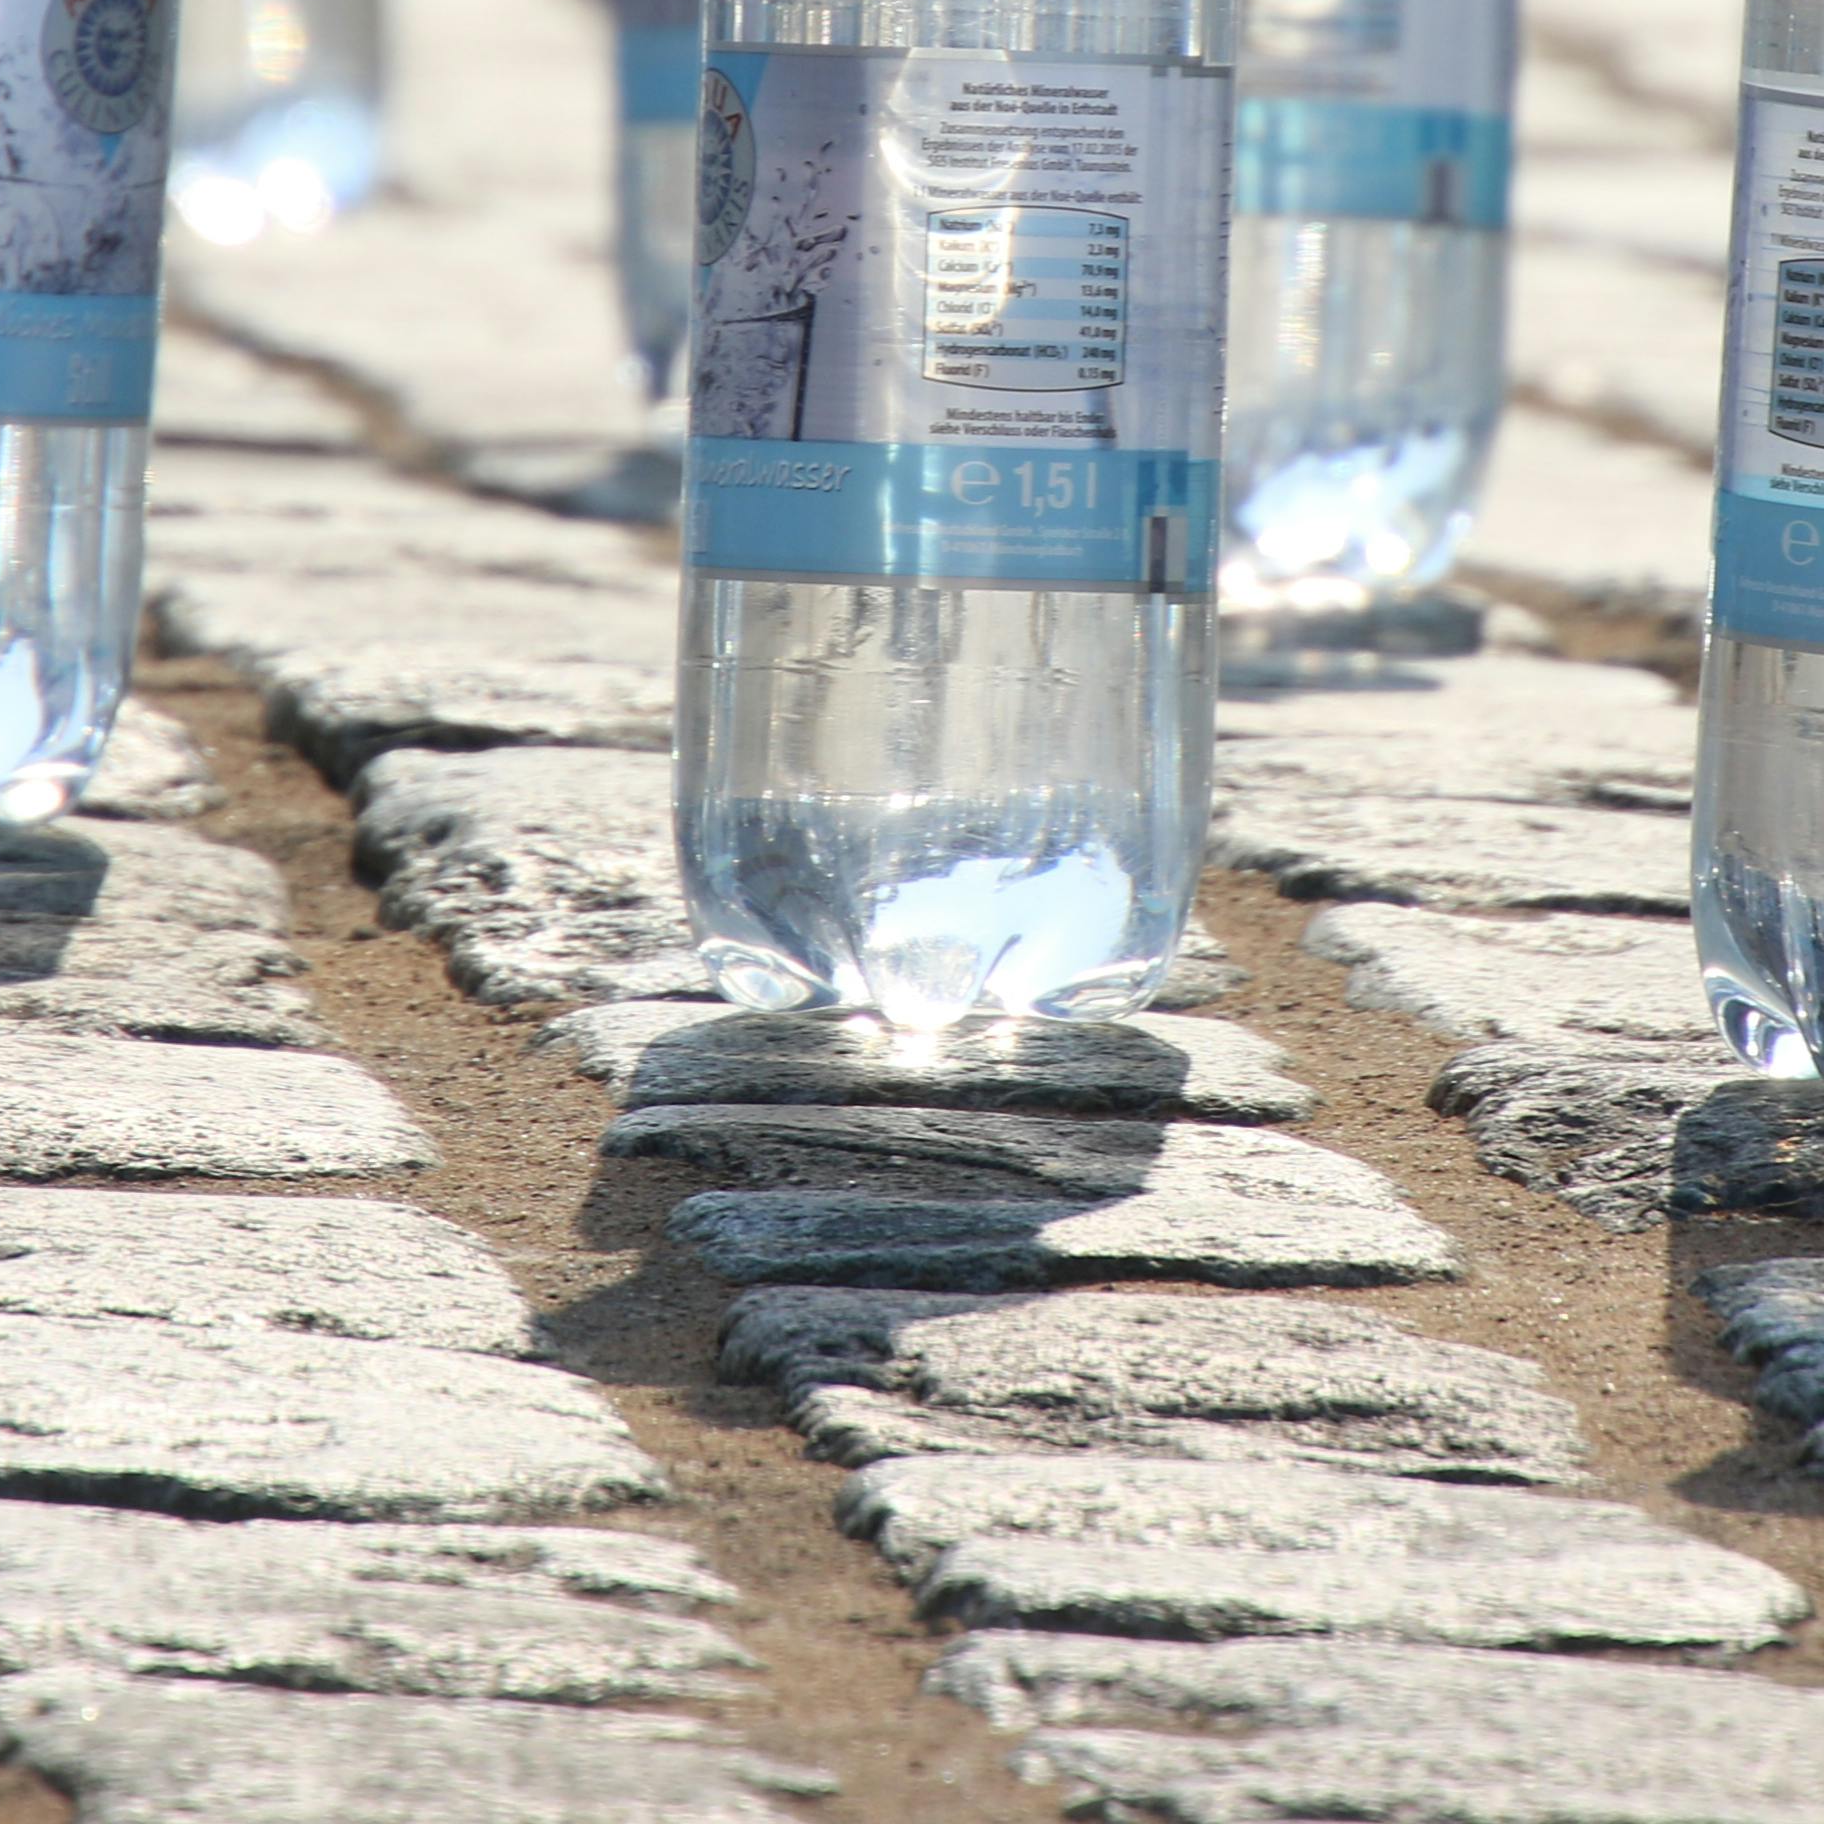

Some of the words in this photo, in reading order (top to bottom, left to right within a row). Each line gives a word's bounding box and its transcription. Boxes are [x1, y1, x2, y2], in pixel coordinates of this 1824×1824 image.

[945, 408, 1013, 422] Mindestens
[1014, 409, 1056, 423] haltbar
[1023, 425, 1050, 437] oder
[1012, 461, 1074, 518] 1,5
